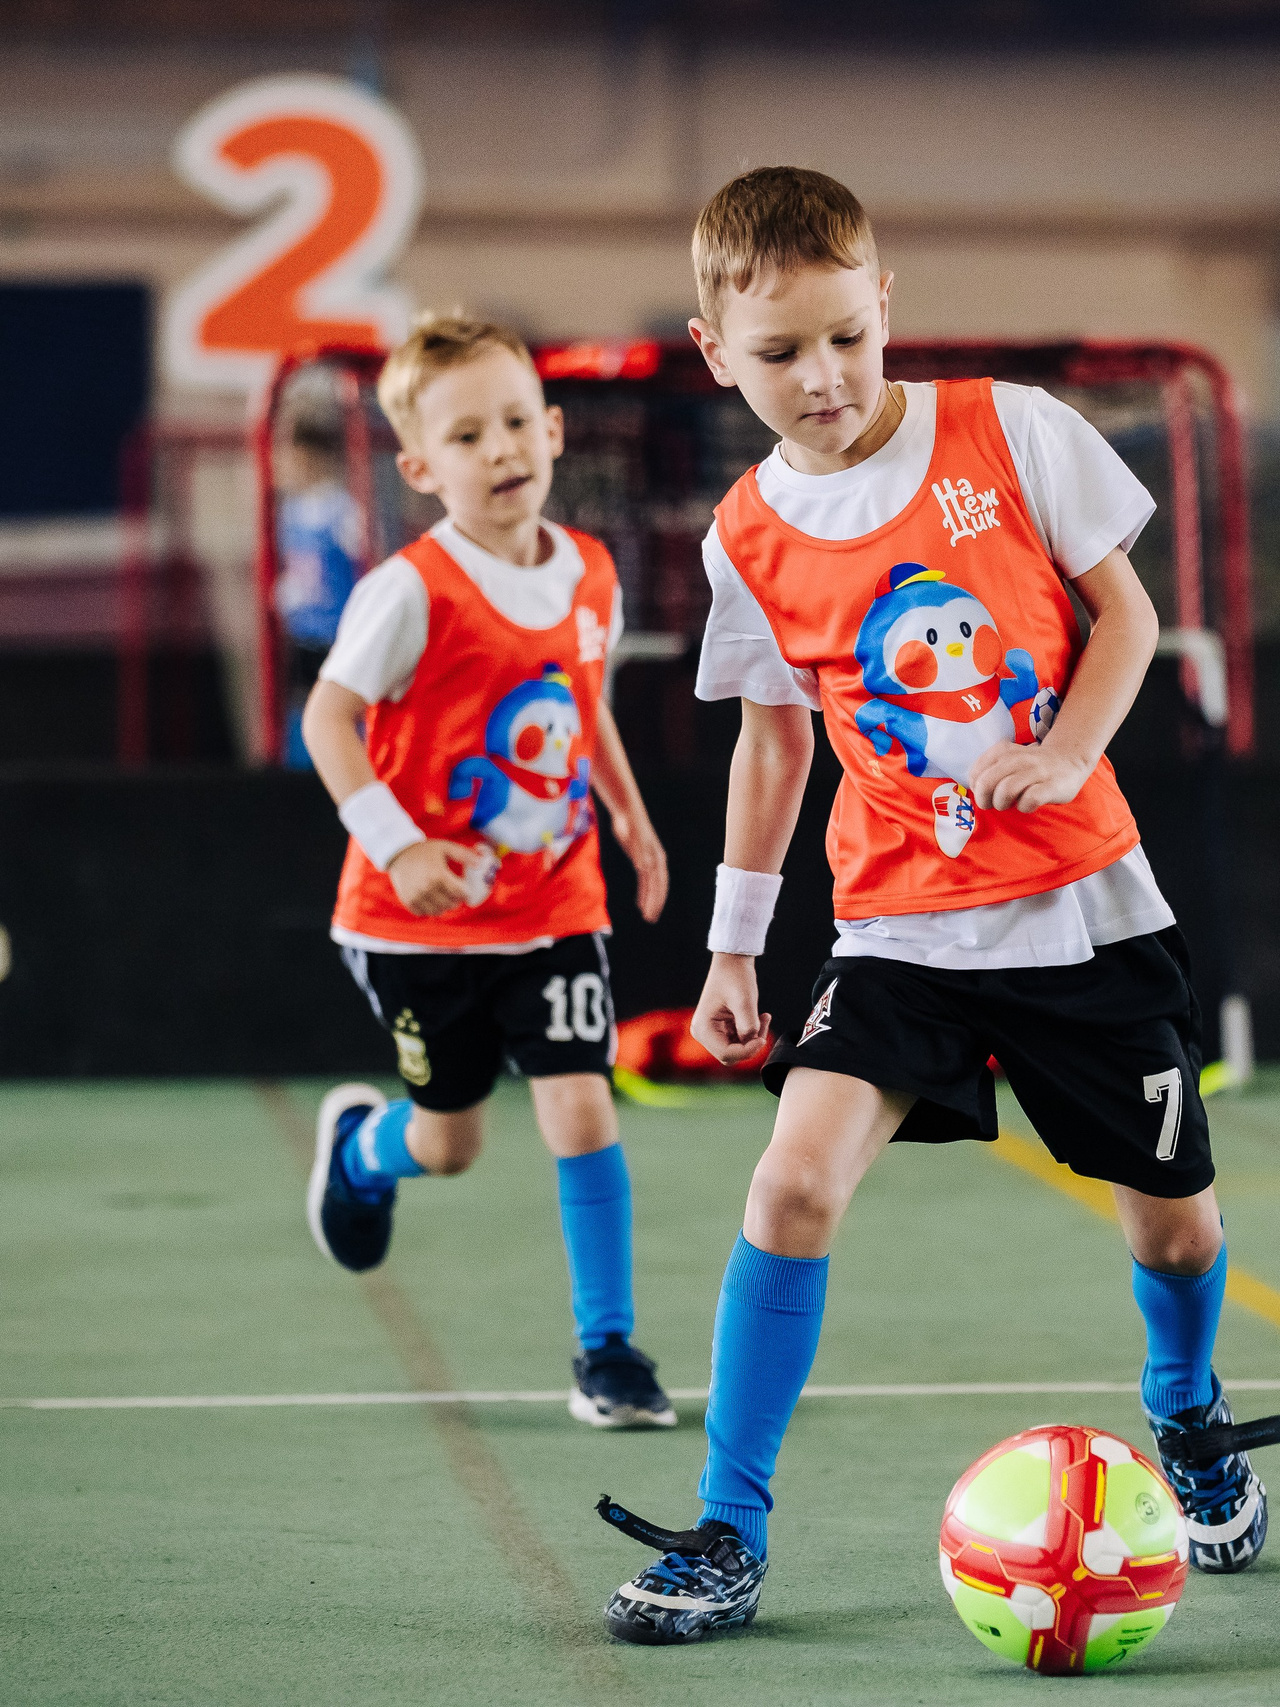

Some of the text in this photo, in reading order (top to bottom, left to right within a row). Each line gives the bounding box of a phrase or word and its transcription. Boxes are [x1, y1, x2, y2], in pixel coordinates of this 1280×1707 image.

[168, 74, 422, 385] 2
[541, 972, 607, 1043] 10
[1142, 1067, 1182, 1161] 7
